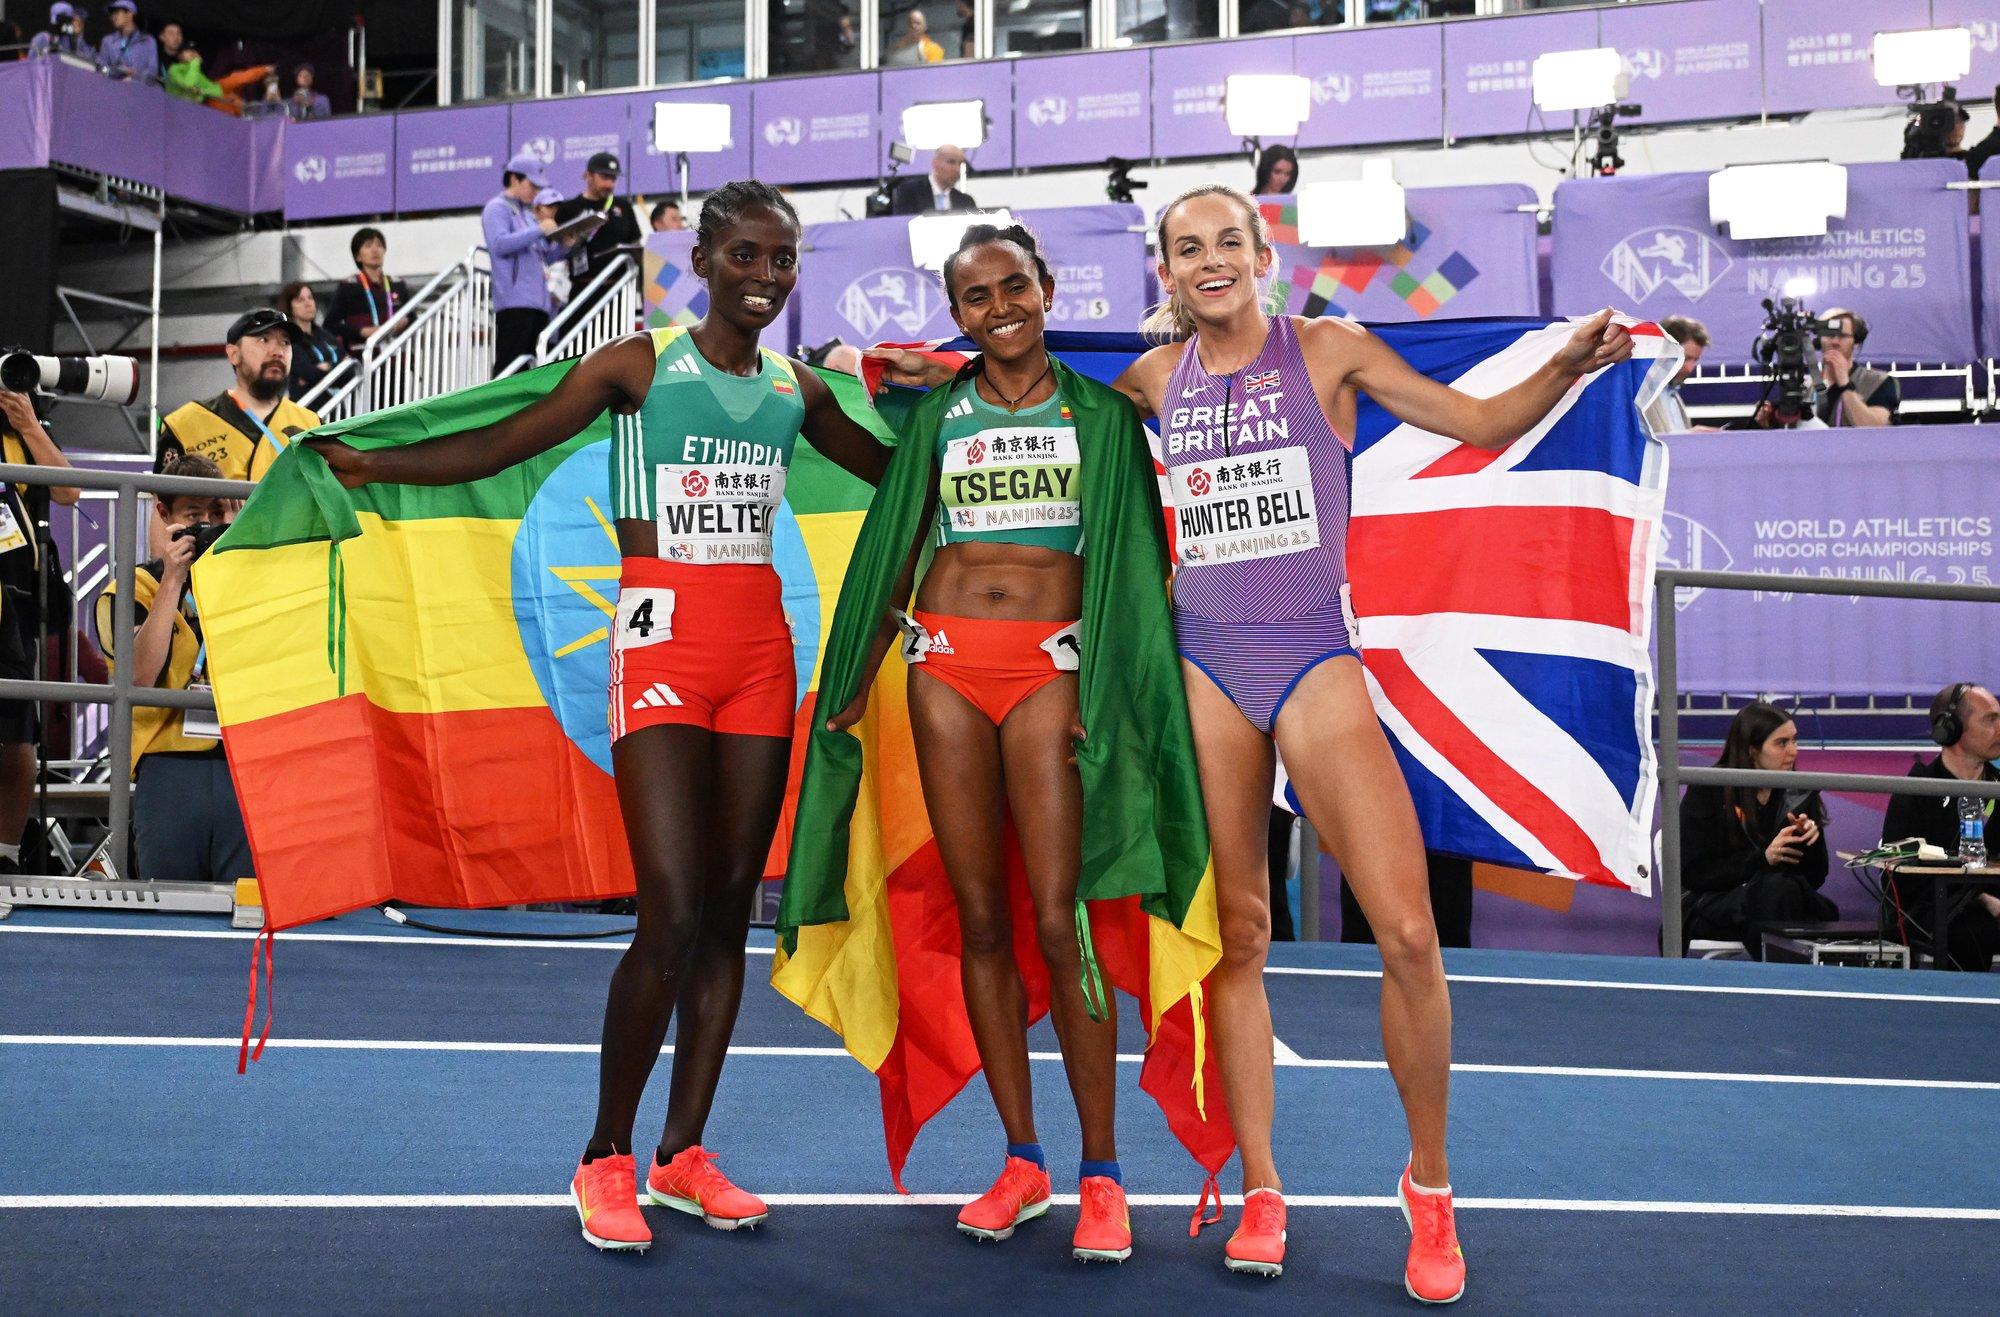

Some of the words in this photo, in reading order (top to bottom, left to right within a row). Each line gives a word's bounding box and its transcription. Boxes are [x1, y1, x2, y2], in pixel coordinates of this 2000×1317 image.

[1822, 228, 1926, 245] ATHLETICS
[1891, 263, 1927, 289] 25
[1171, 392, 1283, 429] GREAT
[991, 435, 1056, 454] 南京银行
[1169, 418, 1288, 454] BRITAIN
[682, 435, 782, 467] ETHIOPIA
[714, 471, 771, 491] 南京银行
[1216, 458, 1281, 484] 南京银行
[1251, 477, 1283, 487] NANJING
[951, 468, 1073, 504] TSEGAY
[985, 505, 1056, 526] NANJING
[1058, 506, 1074, 520] 25
[1180, 499, 1253, 539] HUNTER
[1256, 489, 1310, 527] BELL
[1755, 519, 1846, 540] WORLD
[1853, 517, 1993, 538] ATHLETICS
[1215, 533, 1288, 559] NANJING
[1291, 530, 1311, 545] 25
[1753, 543, 1827, 558] INDOOR
[1832, 541, 1993, 558] CHAMPIONSHIPS
[628, 598, 654, 637] 4
